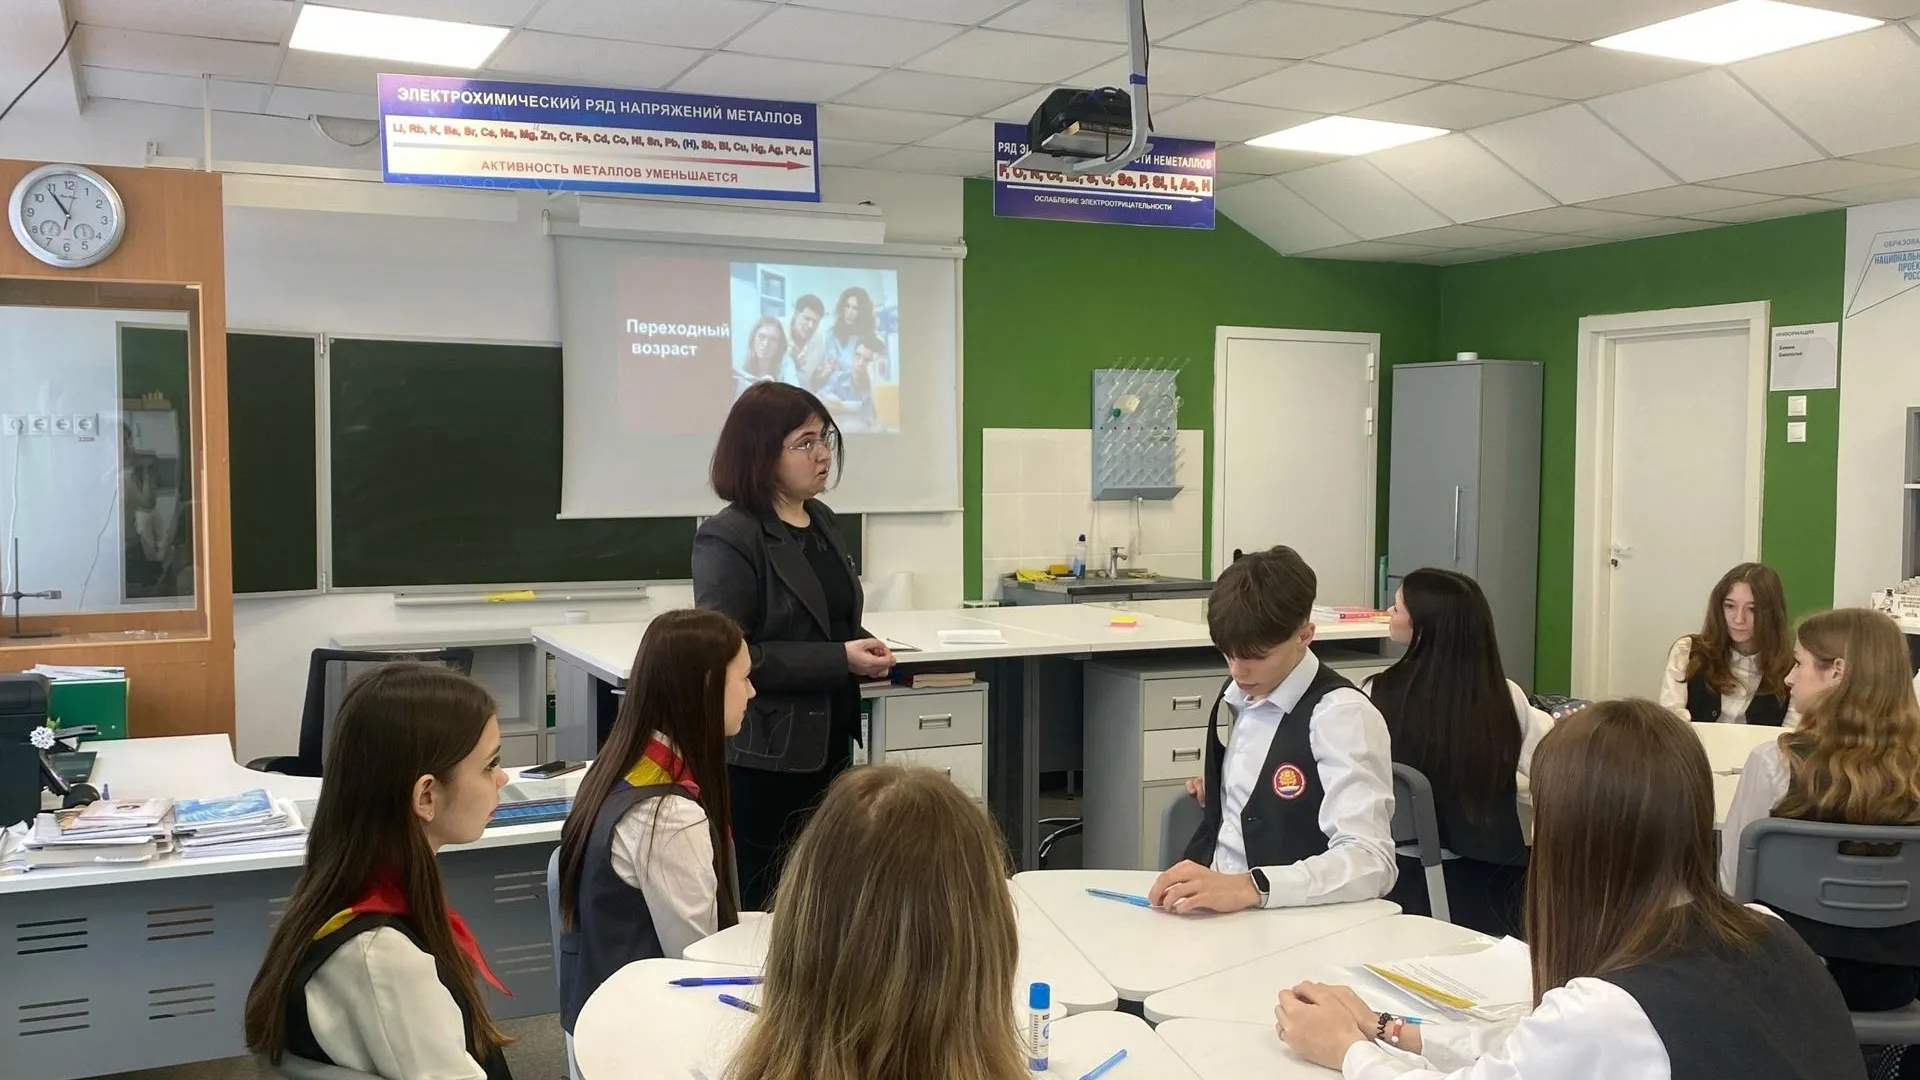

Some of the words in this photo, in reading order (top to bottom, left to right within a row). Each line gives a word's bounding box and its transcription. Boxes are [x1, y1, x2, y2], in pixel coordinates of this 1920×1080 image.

[397, 87, 580, 110] ЭЛЕКТРОХИМИЧЕСКИЙ
[585, 99, 616, 114] РЯД
[620, 101, 722, 120] НАПРЯЖЕНИЙ
[727, 108, 803, 125] МЕТАЛЛОВ
[540, 130, 557, 142] Zn,
[559, 131, 574, 143] Cr,
[593, 132, 611, 145] Cd,
[612, 134, 629, 146] Co,
[665, 137, 681, 149] Pb,
[682, 139, 700, 151] (H),
[733, 142, 749, 154] Cu,
[785, 146, 798, 156] Pt,
[799, 146, 812, 156] Au
[998, 141, 1017, 156] РЯД
[1153, 154, 1212, 169] НЕМЕТАЛЛОВ
[481, 160, 569, 175] АКТИВНОСТЬ
[573, 164, 642, 178] МЕТАЛЛОВ
[645, 168, 738, 183] УМЕНЬШАЕТСЯ
[64, 181, 75, 190] 12
[1139, 174, 1150, 190] P,
[1201, 179, 1211, 192] H
[35, 194, 45, 203] 10
[96, 200, 103, 209] 2
[1034, 195, 1079, 205] ОСЛАБЛЕНИЕ
[1080, 198, 1173, 211] ЭЛЕКТРООТРИЦАТЕЛЬНОСТИ
[27, 208, 35, 217] 9
[101, 216, 108, 225] 3
[32, 226, 38, 234] 8
[46, 238, 53, 247] 7
[64, 243, 71, 252] 6
[82, 242, 89, 250] 5
[626, 319, 730, 337] Переходный
[632, 342, 697, 358] возраст
